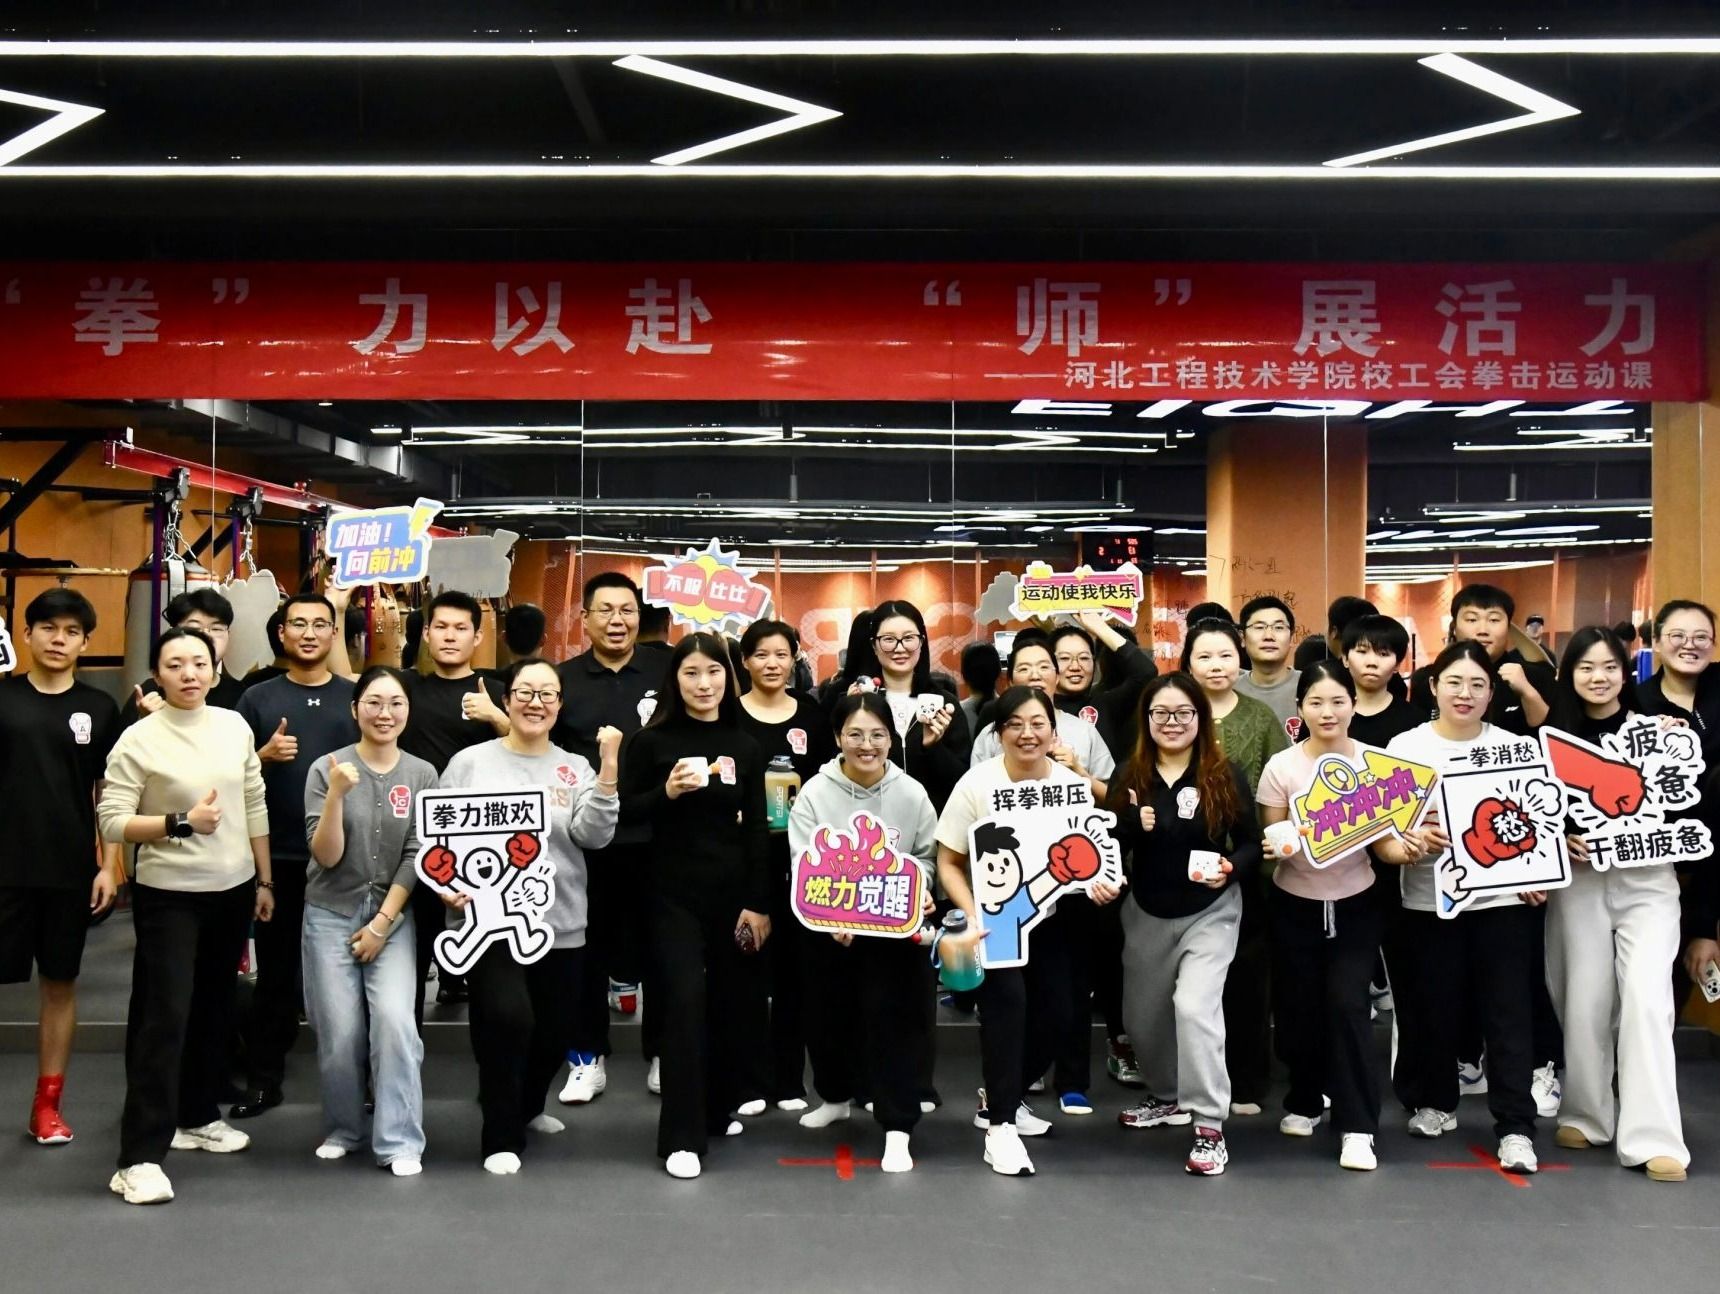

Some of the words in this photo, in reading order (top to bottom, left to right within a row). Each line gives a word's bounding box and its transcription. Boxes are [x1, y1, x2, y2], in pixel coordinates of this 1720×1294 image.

[345, 545, 416, 576] 向前冲
[664, 573, 703, 596] 不服
[709, 581, 748, 603] 比比
[1022, 582, 1138, 602] 运动使我快乐
[1449, 741, 1536, 769] 一拳消愁
[992, 783, 1089, 812] 挥拳解压
[1306, 767, 1418, 842] 冲冲冲
[432, 799, 536, 829] 拳力撒欢
[1492, 814, 1531, 845] 愁
[1588, 825, 1707, 866] 干翻疲惫
[804, 874, 910, 921] 燃力觉醒
